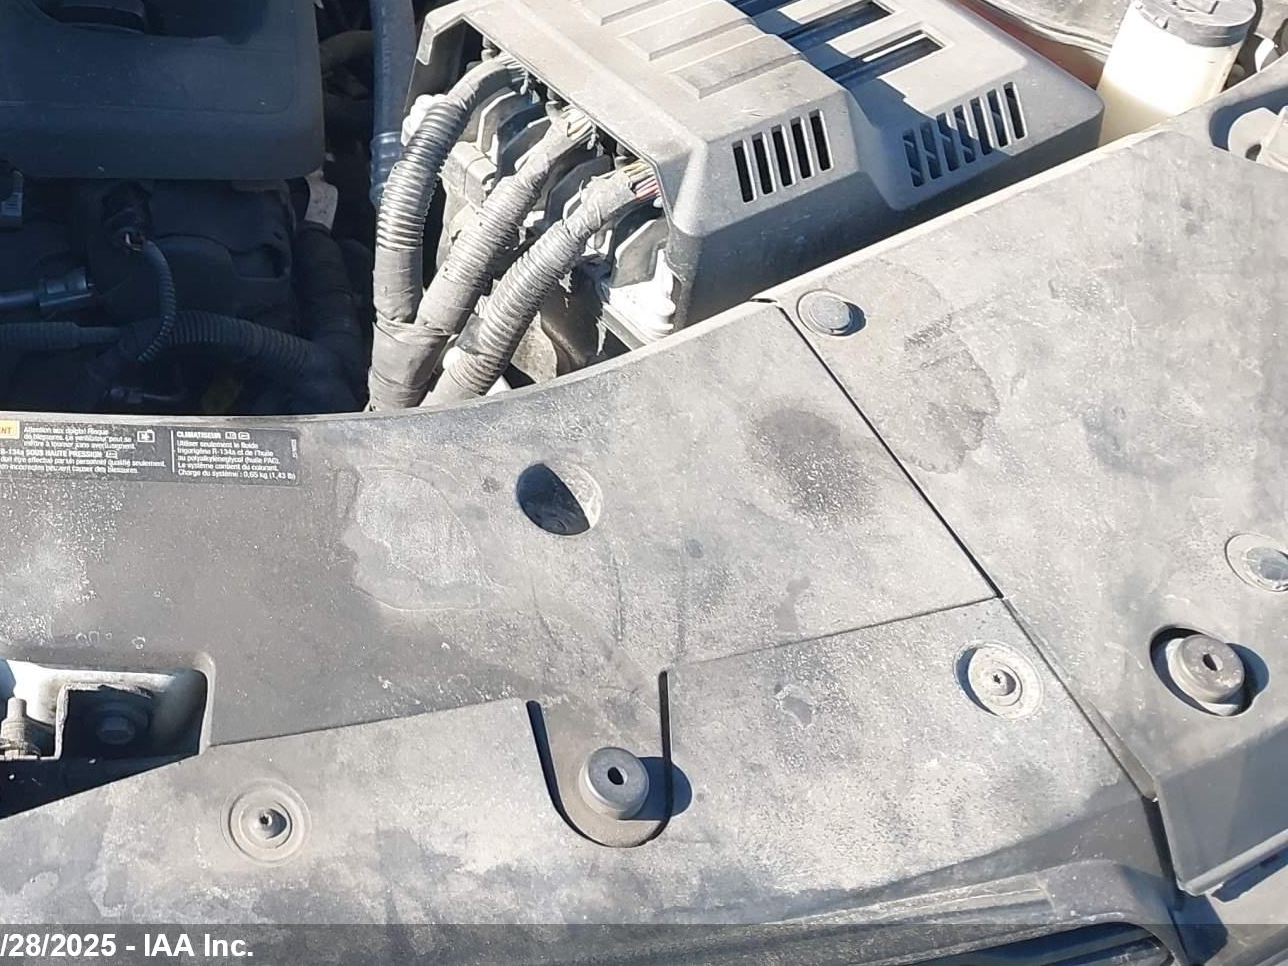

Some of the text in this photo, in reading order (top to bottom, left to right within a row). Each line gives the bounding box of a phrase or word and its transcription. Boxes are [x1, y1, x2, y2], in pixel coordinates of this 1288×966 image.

[24, 425, 52, 434] Attention
[109, 435, 123, 443] peut
[177, 431, 222, 439] CLIMATISEUR
[177, 439, 199, 447] Utiliser
[200, 440, 232, 448] seulement
[25, 448, 44, 456] SOUS
[45, 449, 68, 457] HAUTE
[69, 450, 103, 458] PRESSION
[212, 447, 236, 455] R-134a
[178, 468, 201, 477] Charge
[202, 469, 211, 477] du
[259, 472, 268, 480] kg
